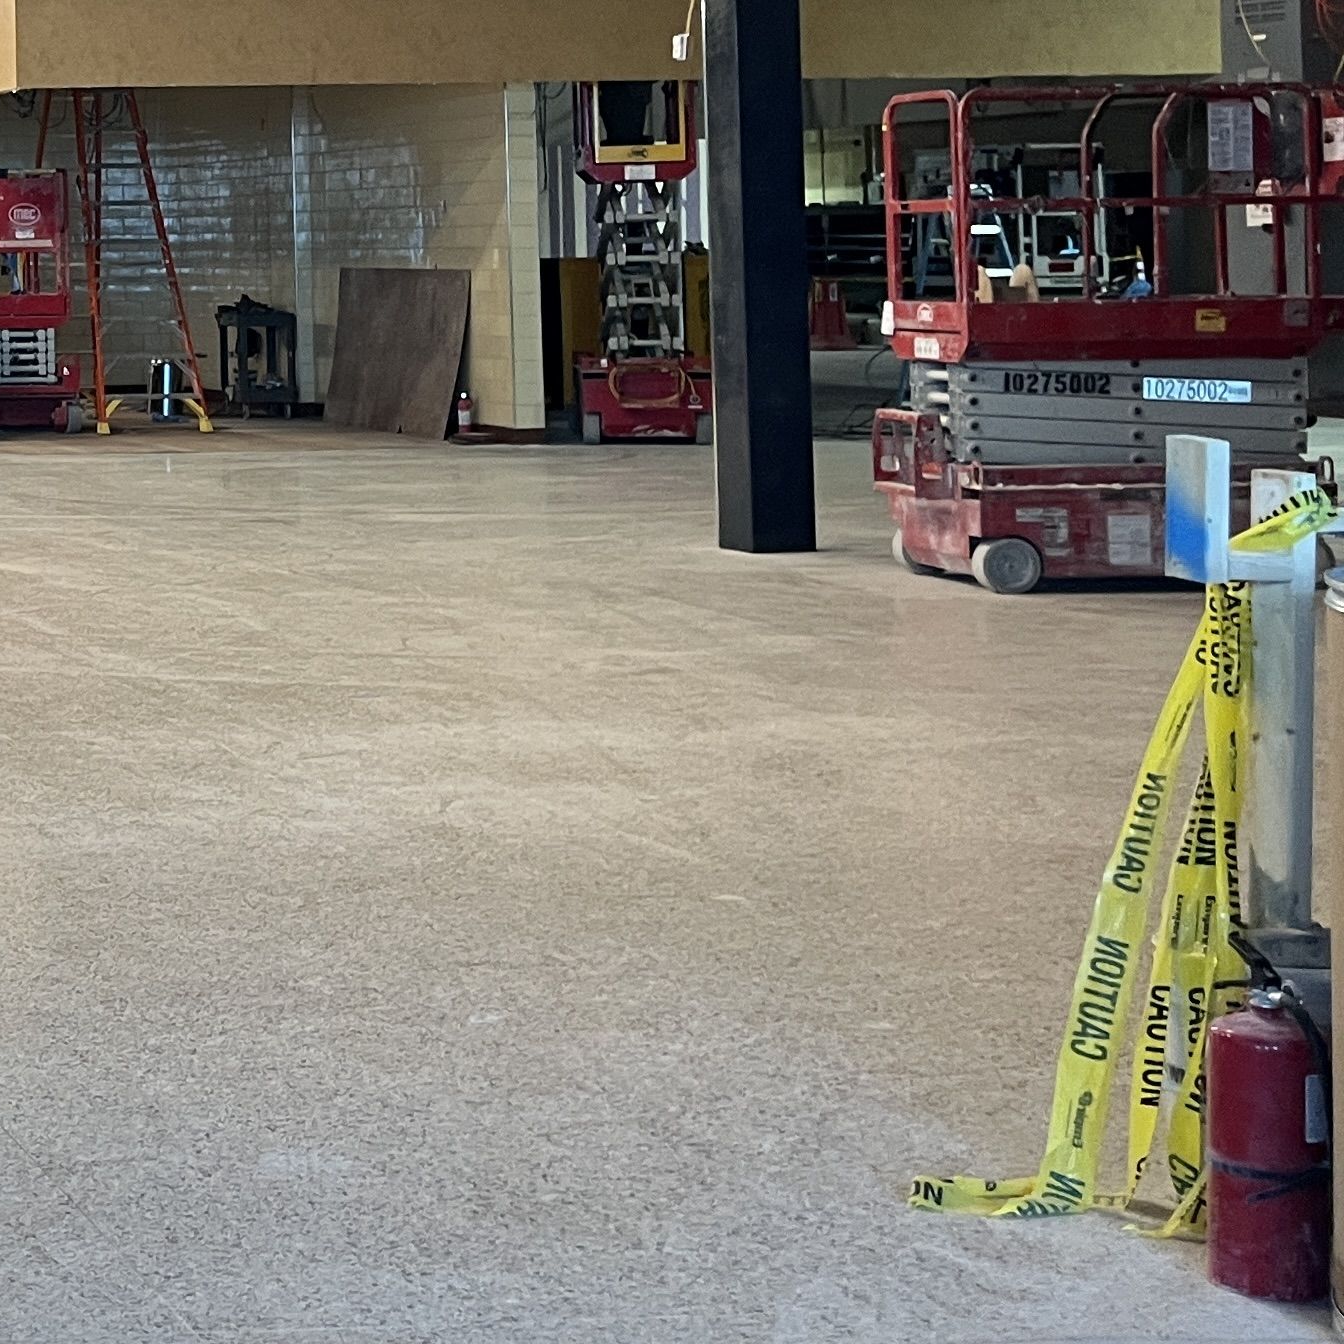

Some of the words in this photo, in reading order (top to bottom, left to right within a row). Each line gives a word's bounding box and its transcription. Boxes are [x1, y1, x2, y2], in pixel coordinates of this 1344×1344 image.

[1004, 372, 1111, 395] 10275002
[1146, 379, 1228, 401] 10275002
[1140, 985, 1170, 1106] CAUTION
